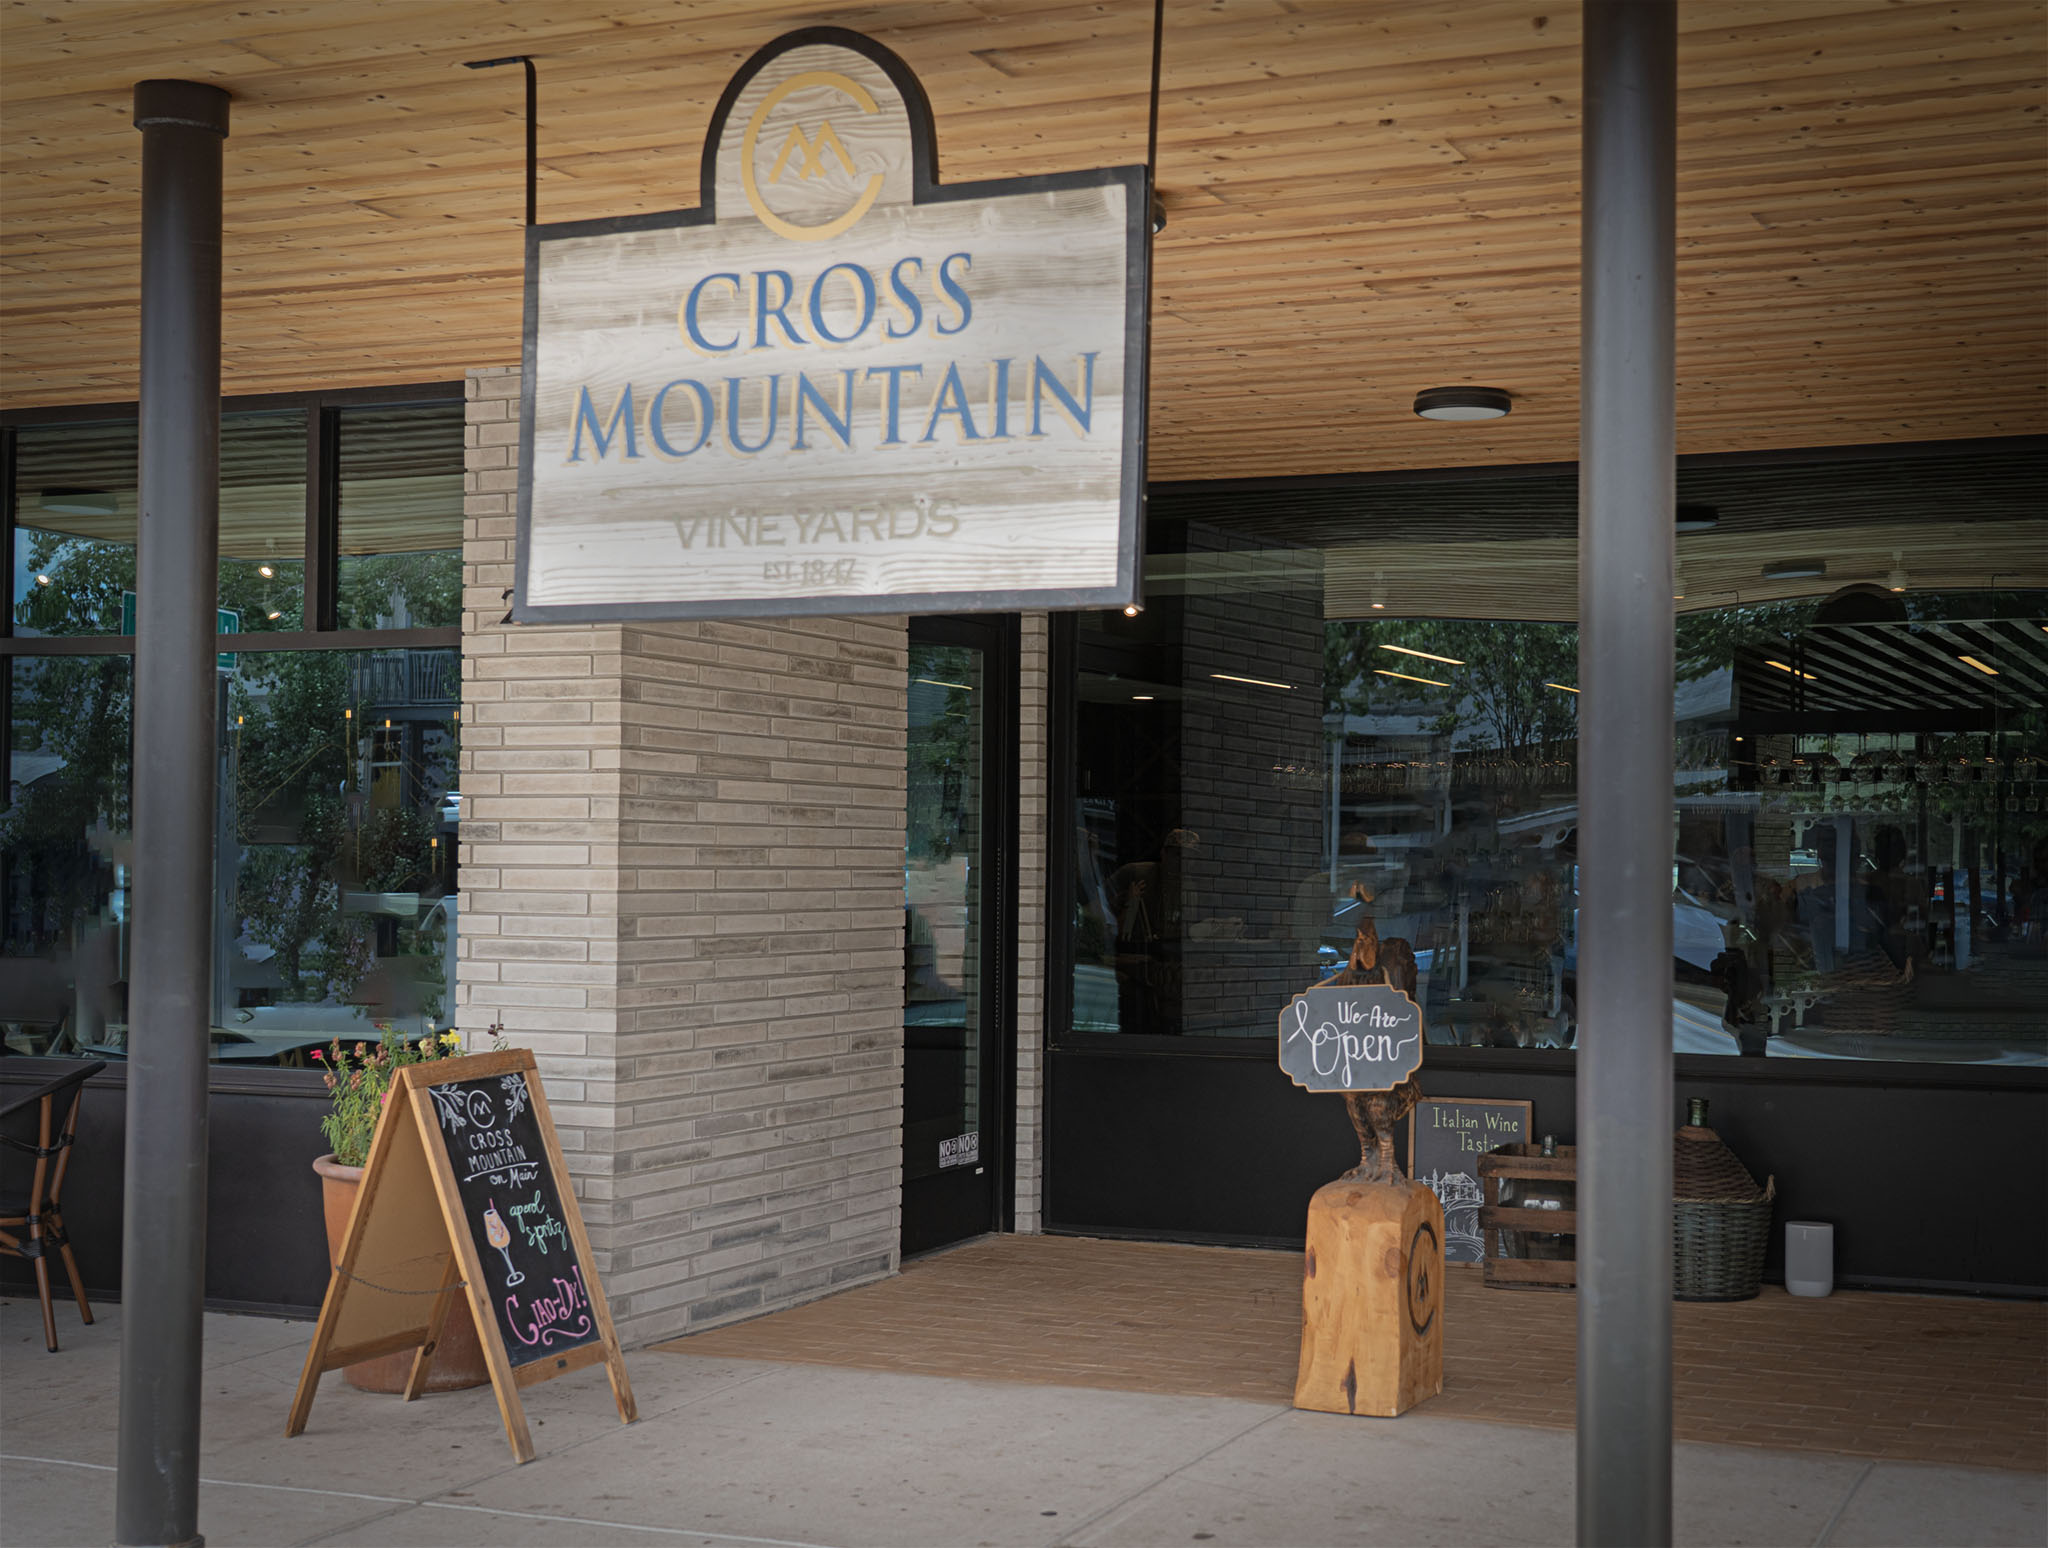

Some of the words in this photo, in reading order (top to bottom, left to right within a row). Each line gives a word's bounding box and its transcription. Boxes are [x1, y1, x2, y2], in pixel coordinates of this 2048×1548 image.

[680, 252, 972, 357] CROSS
[563, 352, 1100, 467] MOUNTAIN
[673, 498, 961, 550] VINEYARDS
[1338, 1001, 1366, 1024] We
[1369, 1005, 1412, 1028] Are
[1288, 1001, 1418, 1087] Open
[1432, 1107, 1479, 1129] Italian
[1484, 1112, 1518, 1133] Wine
[469, 1128, 514, 1151] CROSS
[1456, 1131, 1500, 1152] Tasti
[468, 1145, 527, 1172] MOUNTAIN
[489, 1175, 508, 1185] on
[510, 1168, 538, 1189] Main
[509, 1189, 545, 1234] aperol
